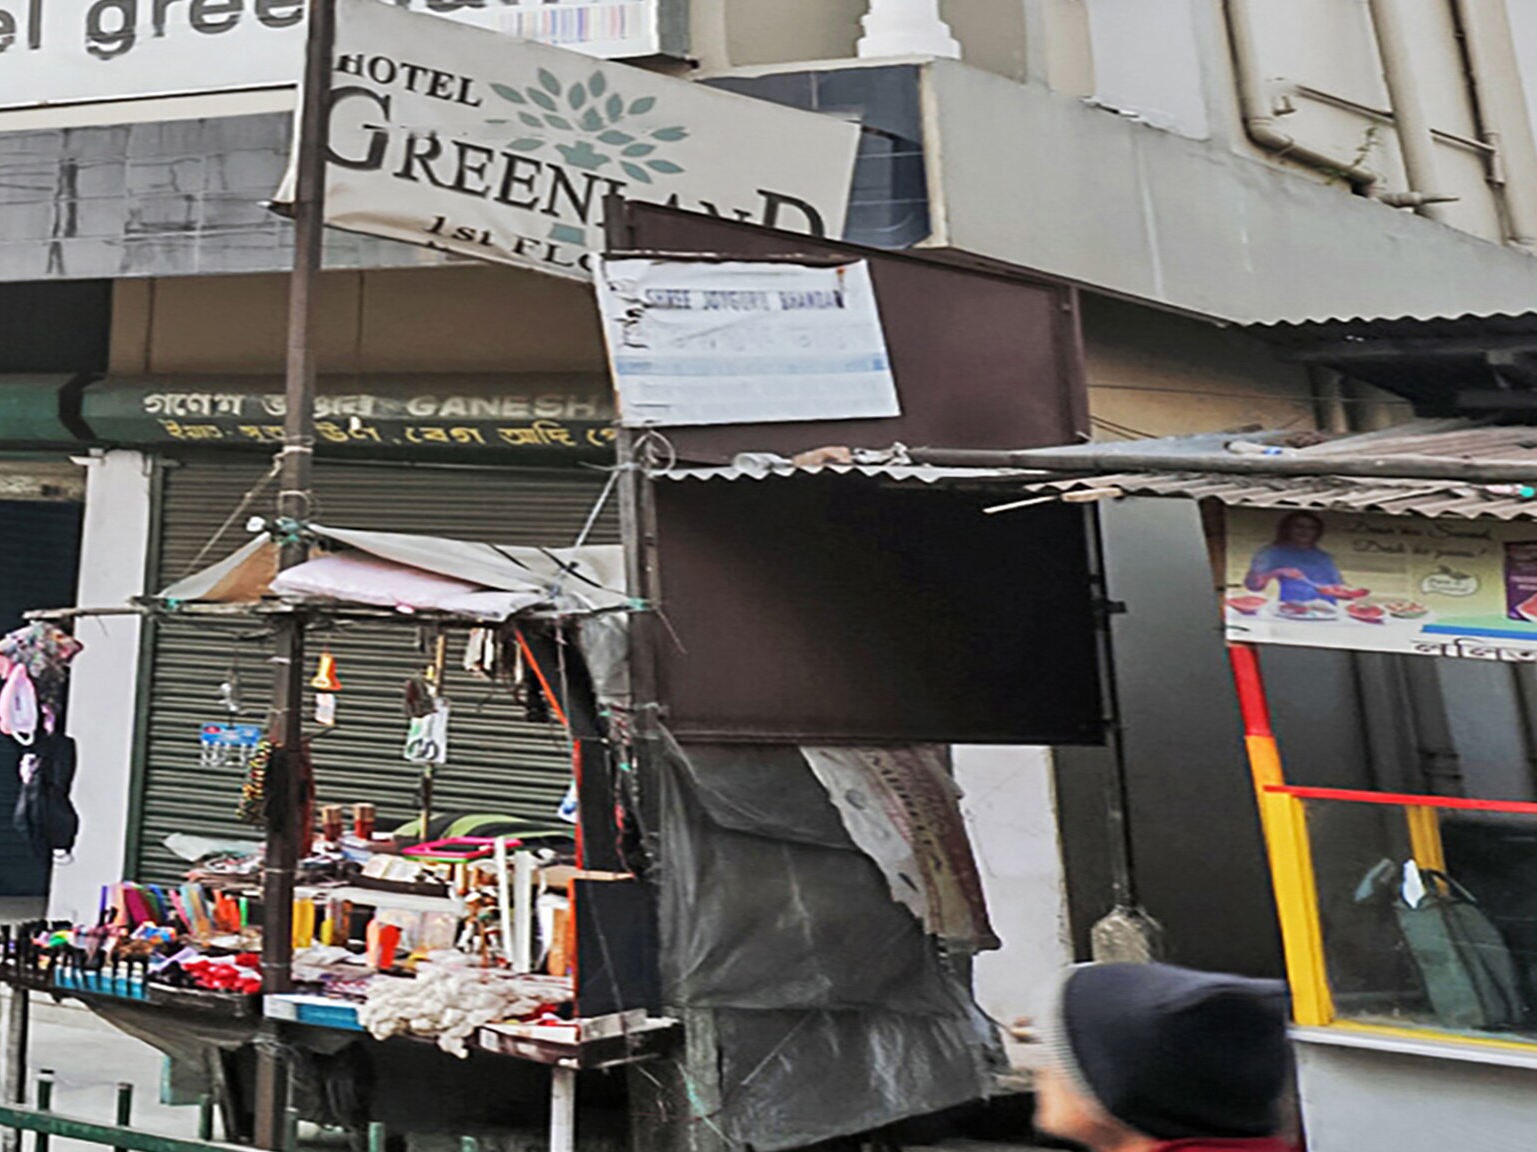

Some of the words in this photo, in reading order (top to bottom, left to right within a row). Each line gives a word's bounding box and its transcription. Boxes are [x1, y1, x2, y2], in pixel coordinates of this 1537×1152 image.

[335, 52, 484, 109] HOTEL
[325, 85, 828, 239] GREENLD
[424, 214, 493, 247] 1st
[405, 392, 599, 418] GANESH
